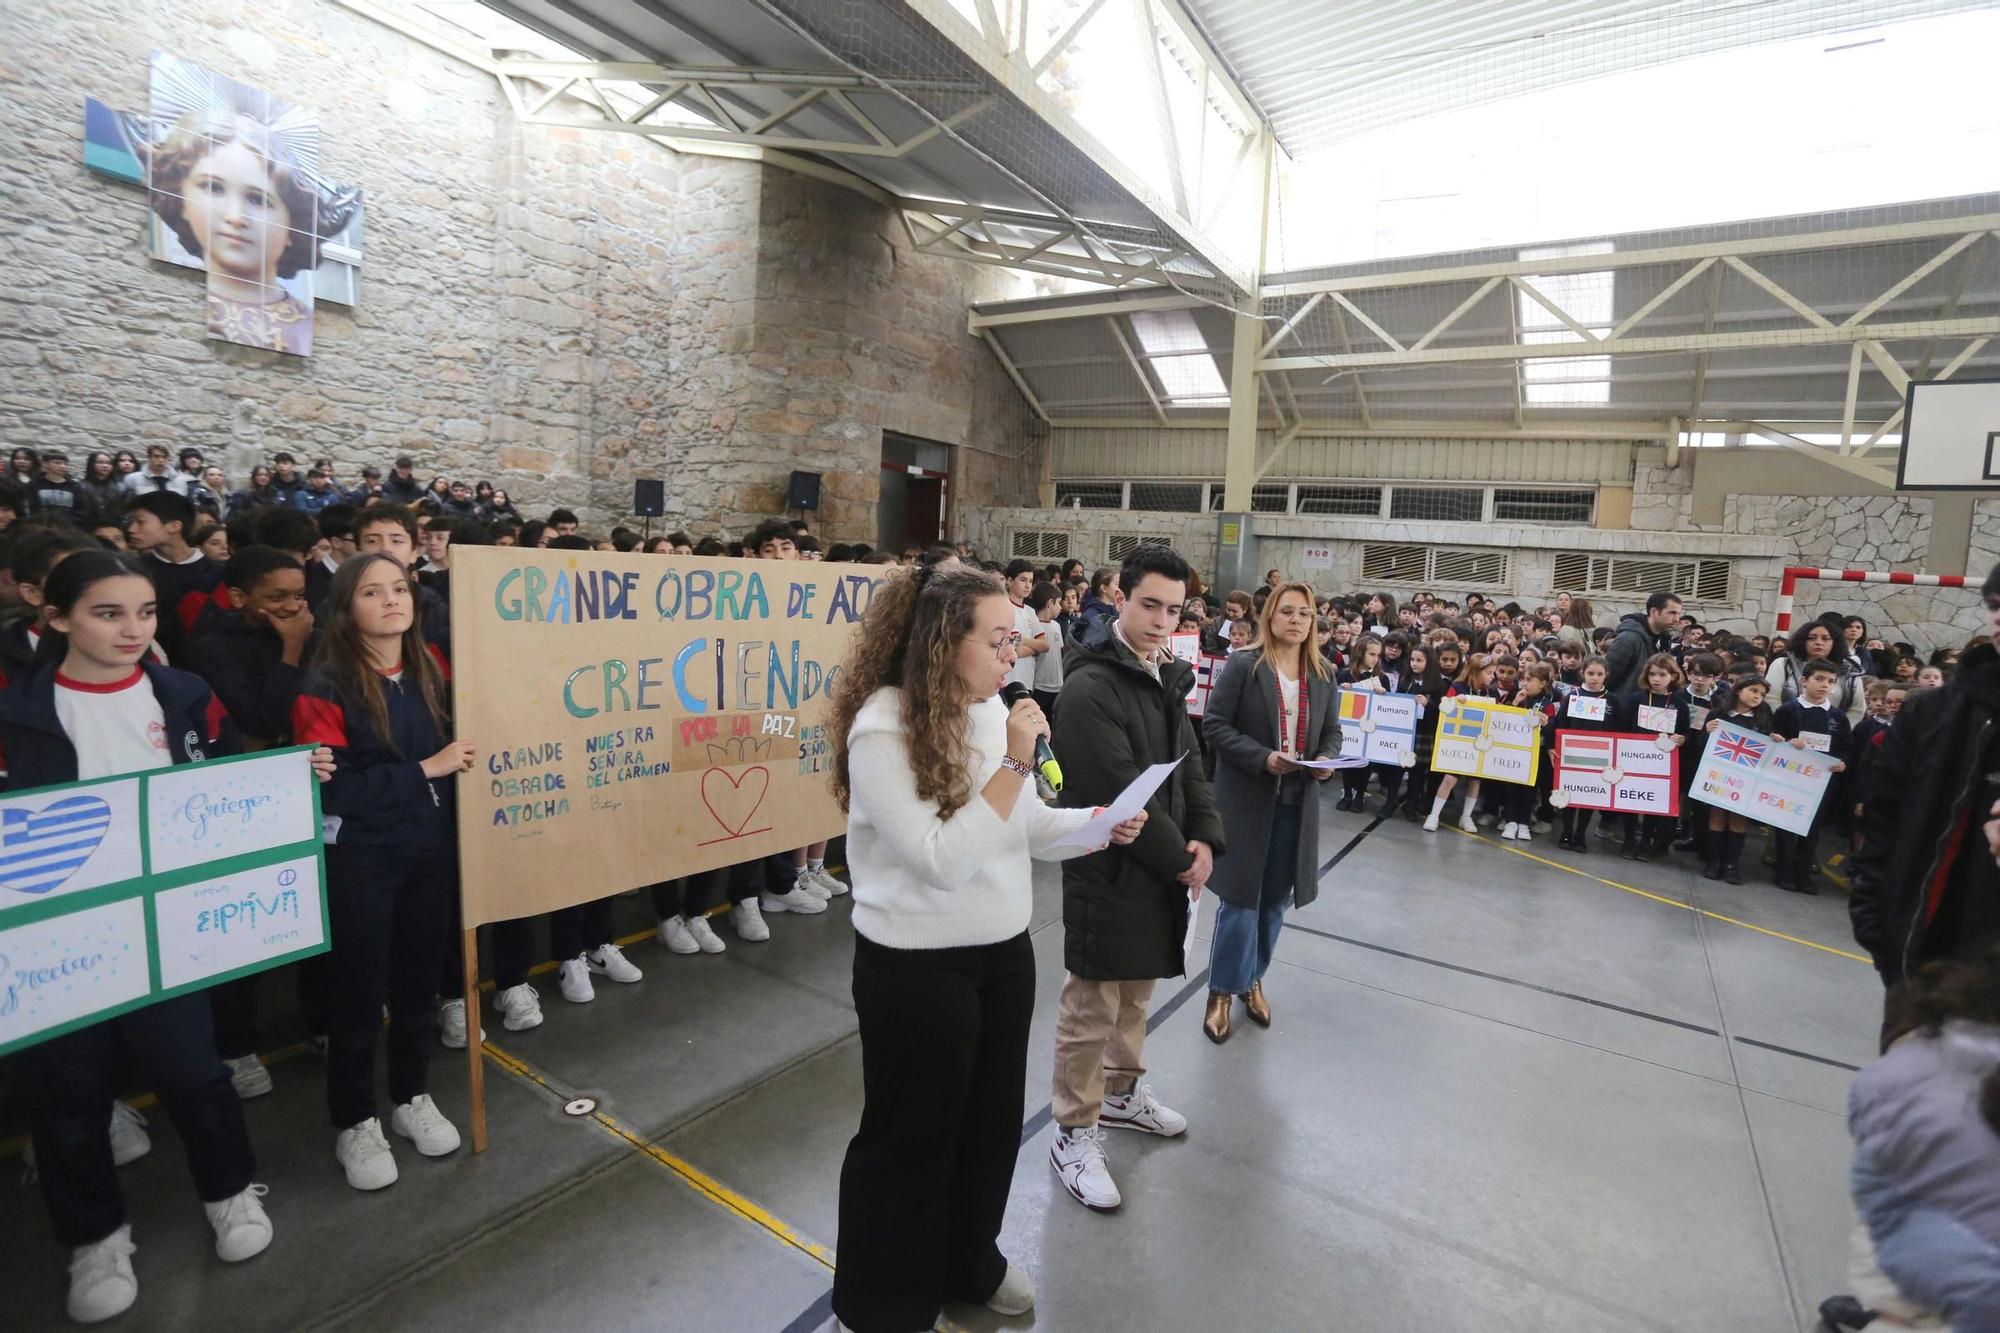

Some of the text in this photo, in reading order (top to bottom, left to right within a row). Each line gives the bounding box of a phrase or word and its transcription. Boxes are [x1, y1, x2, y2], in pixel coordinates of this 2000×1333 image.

[495, 566, 640, 624] GRANDE
[656, 568, 770, 622] OBRA
[787, 582, 817, 618] DE
[1376, 704, 1409, 716] Rumano
[680, 714, 796, 746] POR LA PAZ
[1491, 719, 1531, 734] SUECO
[586, 726, 655, 752] NUESTRA
[1379, 740, 1399, 750] PACE
[488, 742, 563, 775] GRANDE
[588, 750, 645, 772] SEÑORA
[1440, 748, 1475, 761] SUECIA
[1492, 756, 1521, 769] FRED
[1620, 751, 1665, 761] HUNGARO
[587, 762, 670, 789] DEL CARMEN
[1708, 769, 1744, 788] REINO
[1772, 756, 1823, 779] INGLÉS
[1619, 788, 1656, 802] BÉKE
[1759, 791, 1808, 816] PEACE
[176, 793, 271, 841] Griego
[492, 798, 571, 826] ATOCHA
